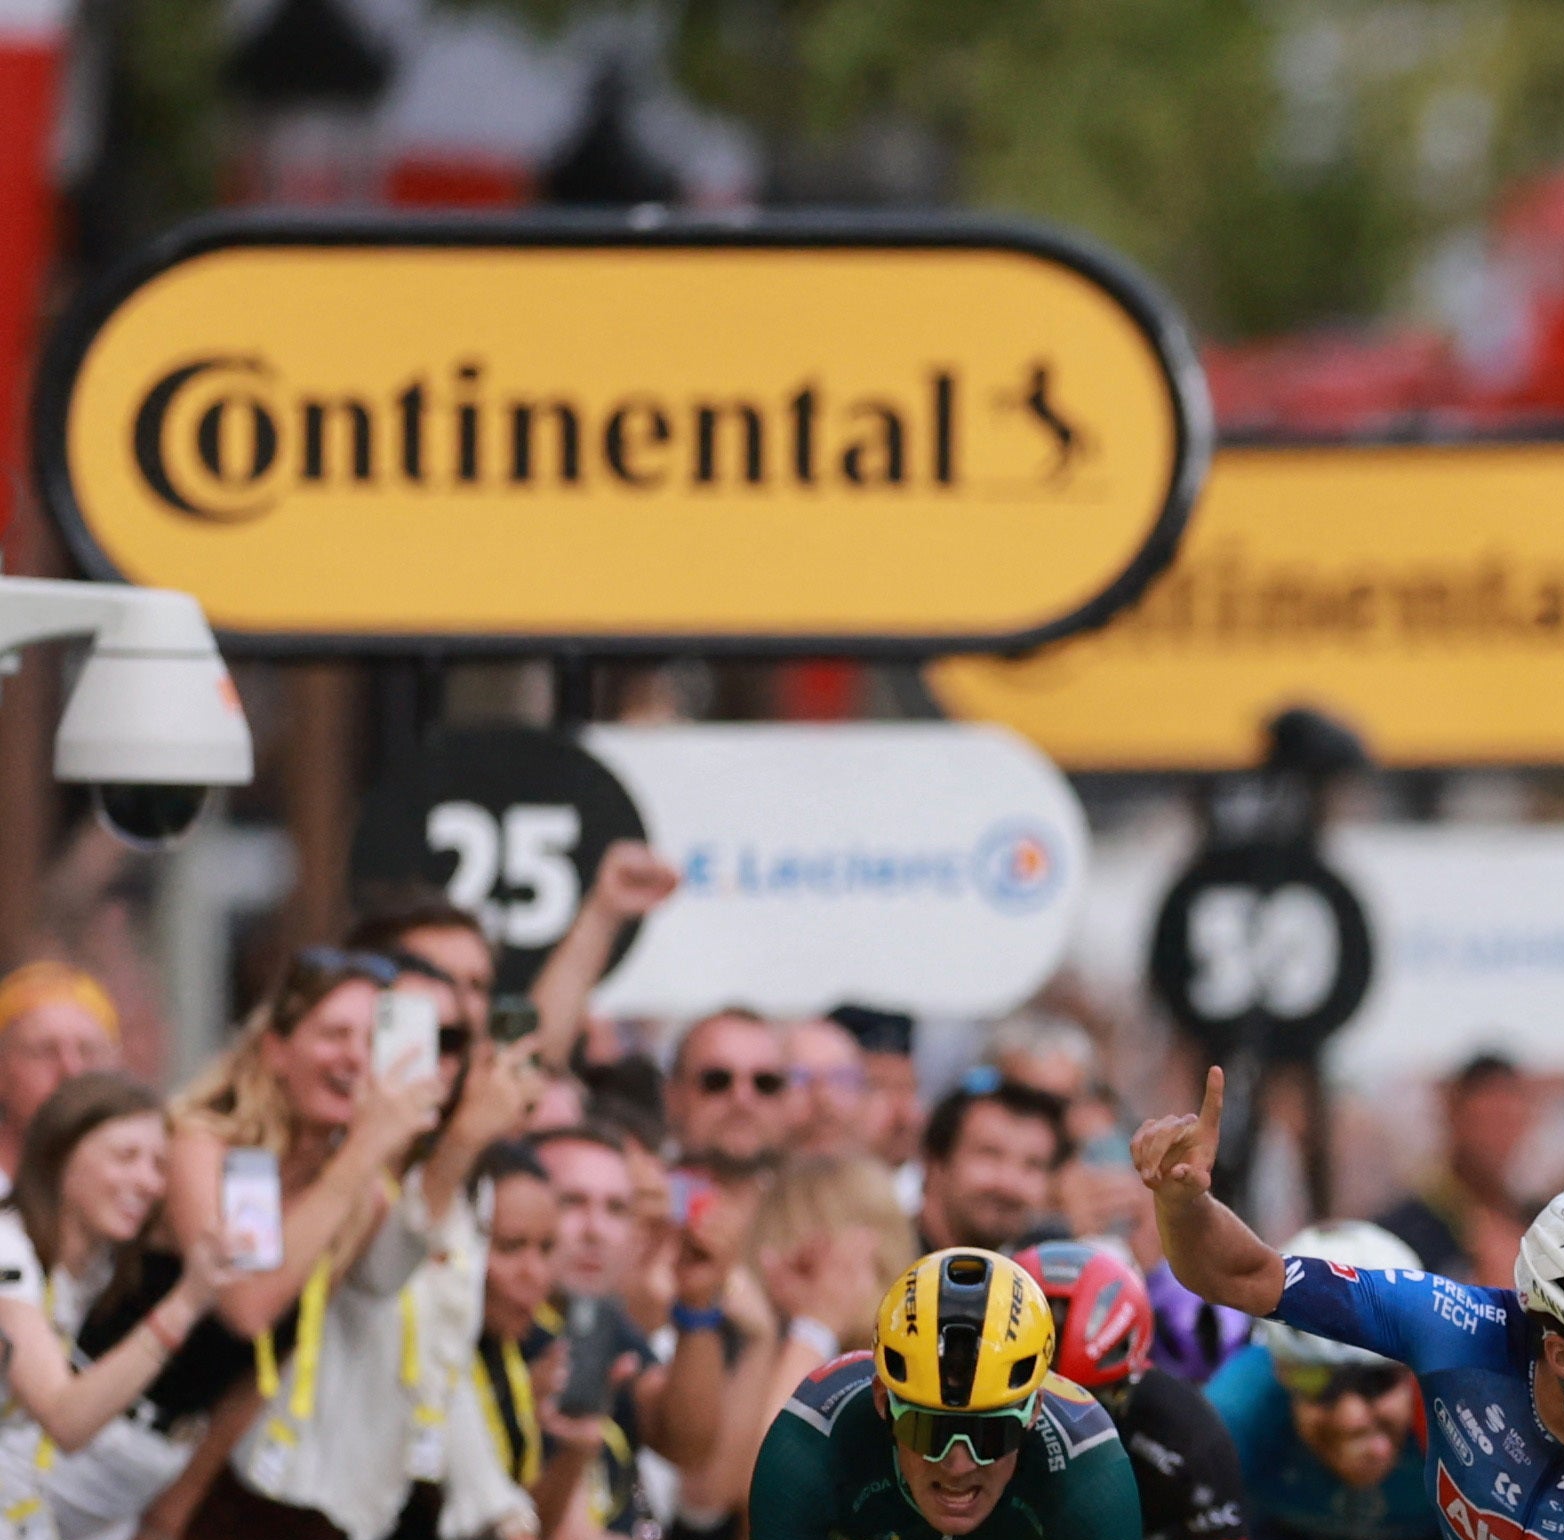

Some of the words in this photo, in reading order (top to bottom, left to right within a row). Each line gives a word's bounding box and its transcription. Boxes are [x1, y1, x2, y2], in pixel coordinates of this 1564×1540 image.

[131, 350, 955, 524] Continental
[424, 800, 582, 948] 25
[1186, 883, 1340, 1020] 50
[904, 1269, 919, 1337] TREK
[1005, 1274, 1025, 1342] TREK
[1431, 1274, 1508, 1328] PREMIER
[1431, 1290, 1479, 1336] TECH
